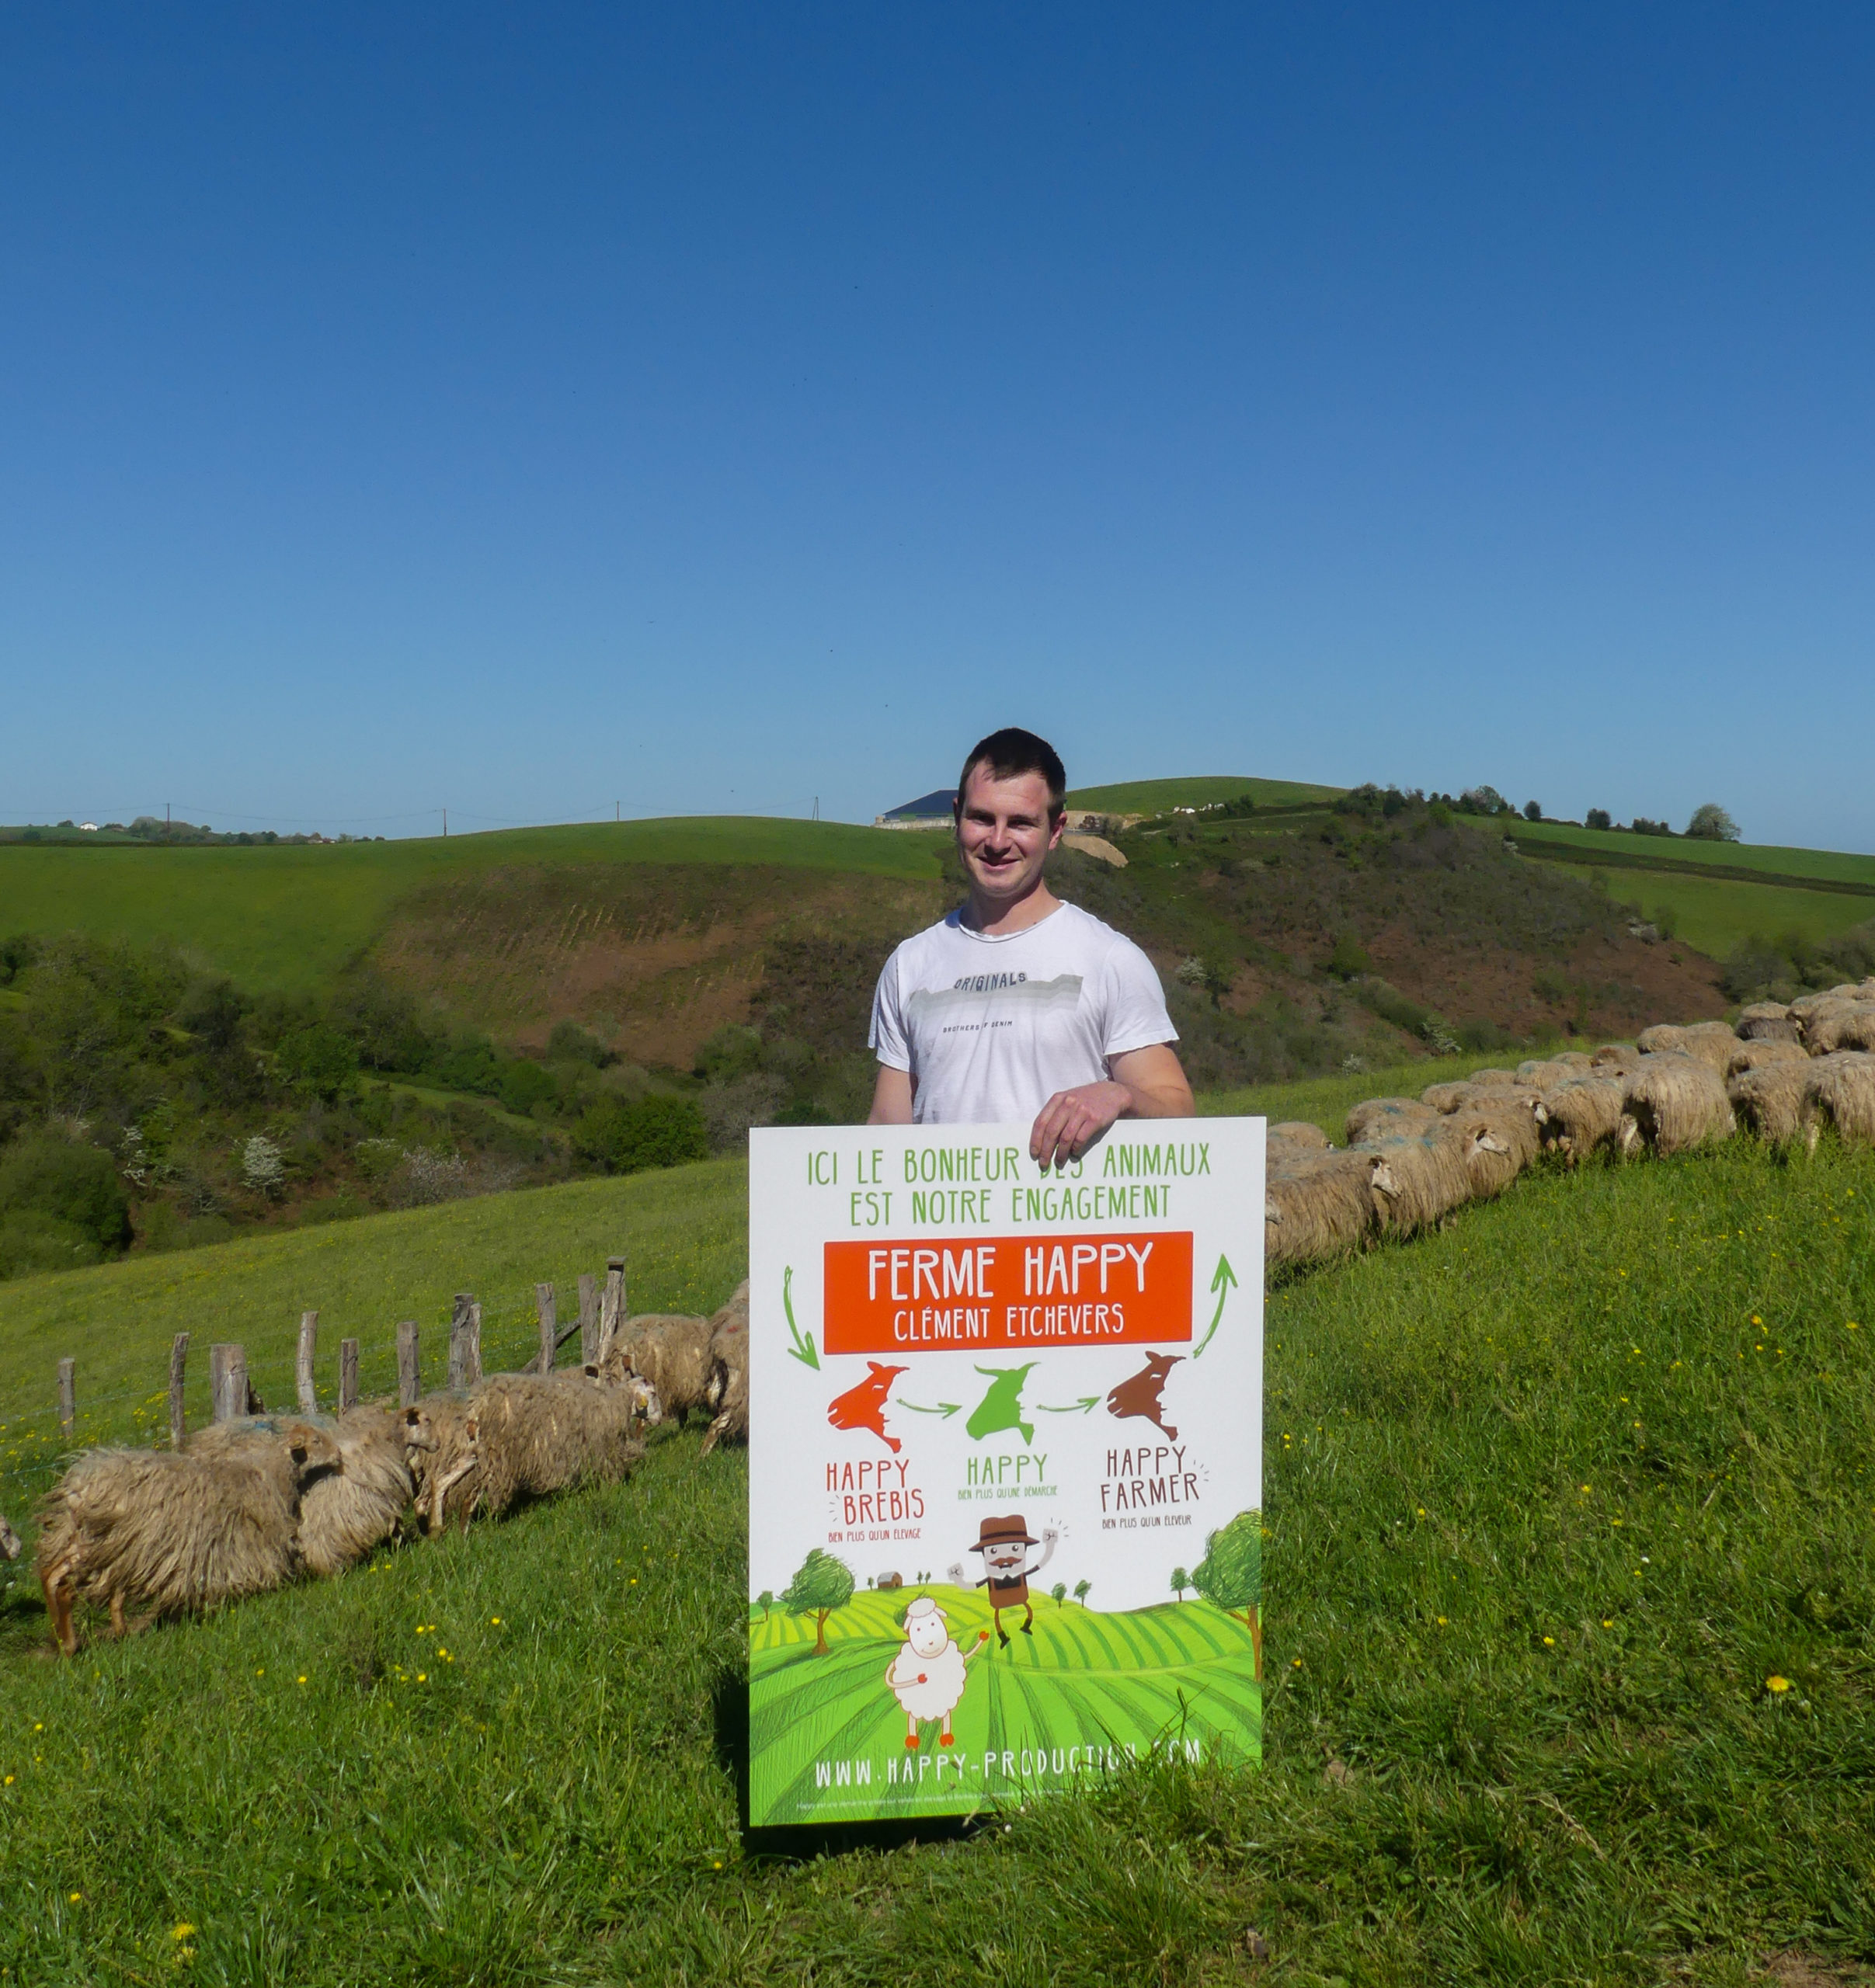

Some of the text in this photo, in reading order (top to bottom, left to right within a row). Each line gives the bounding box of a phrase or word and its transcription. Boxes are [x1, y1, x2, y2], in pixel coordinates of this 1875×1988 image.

[954, 972, 1026, 992] ORIGINALS
[808, 1150, 838, 1186] ICI
[857, 1149, 884, 1184] LE
[904, 1146, 1021, 1183] BONHEUR
[1103, 1142, 1211, 1178] ANIMAUX
[851, 1184, 1171, 1227] EST NOTRE ENGAGEMENT
[868, 1241, 1153, 1301] FERME HAPPY
[894, 1302, 1125, 1341] CLÉMENT ETCHEVERS
[826, 1458, 910, 1492] HAPPY
[967, 1453, 1048, 1486] HAPPY
[1107, 1445, 1187, 1478] HAPPY
[844, 1488, 924, 1526] BREBIS
[958, 1489, 972, 1500] BIEN
[976, 1488, 993, 1500] PLUS
[997, 1486, 1020, 1499] QU'UNE
[1100, 1472, 1200, 1513] FARMER
[828, 1531, 844, 1544] BIEN
[847, 1530, 865, 1542] PLUS
[868, 1529, 890, 1541] QU'UN
[1102, 1518, 1116, 1530] BIEN
[1119, 1517, 1137, 1529] PLUS
[1140, 1516, 1161, 1527] QU'UN
